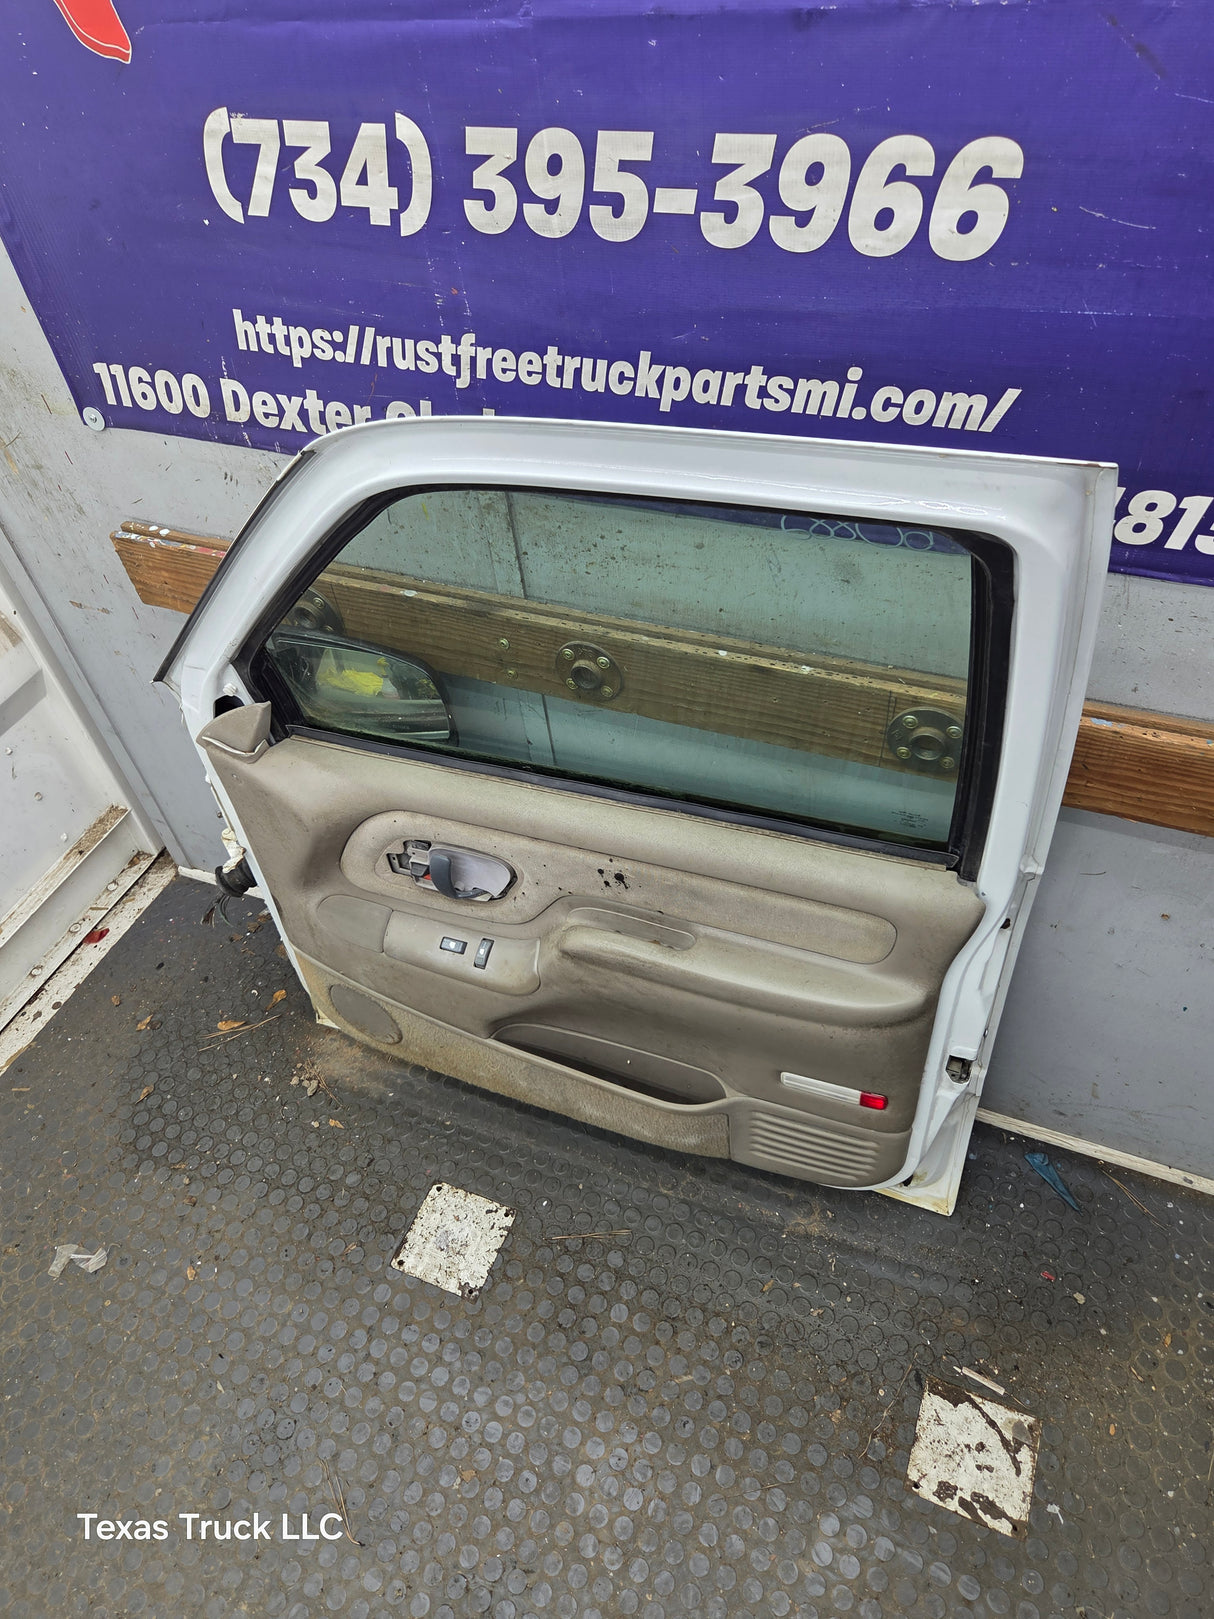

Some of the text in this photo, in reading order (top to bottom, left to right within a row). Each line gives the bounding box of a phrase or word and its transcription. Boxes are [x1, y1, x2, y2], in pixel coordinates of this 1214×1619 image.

[203, 106, 1025, 262] (734) 395-3966
[92, 362, 212, 418] 11600
[232, 308, 1023, 434] https://rustfreetruckpartsmi.com/
